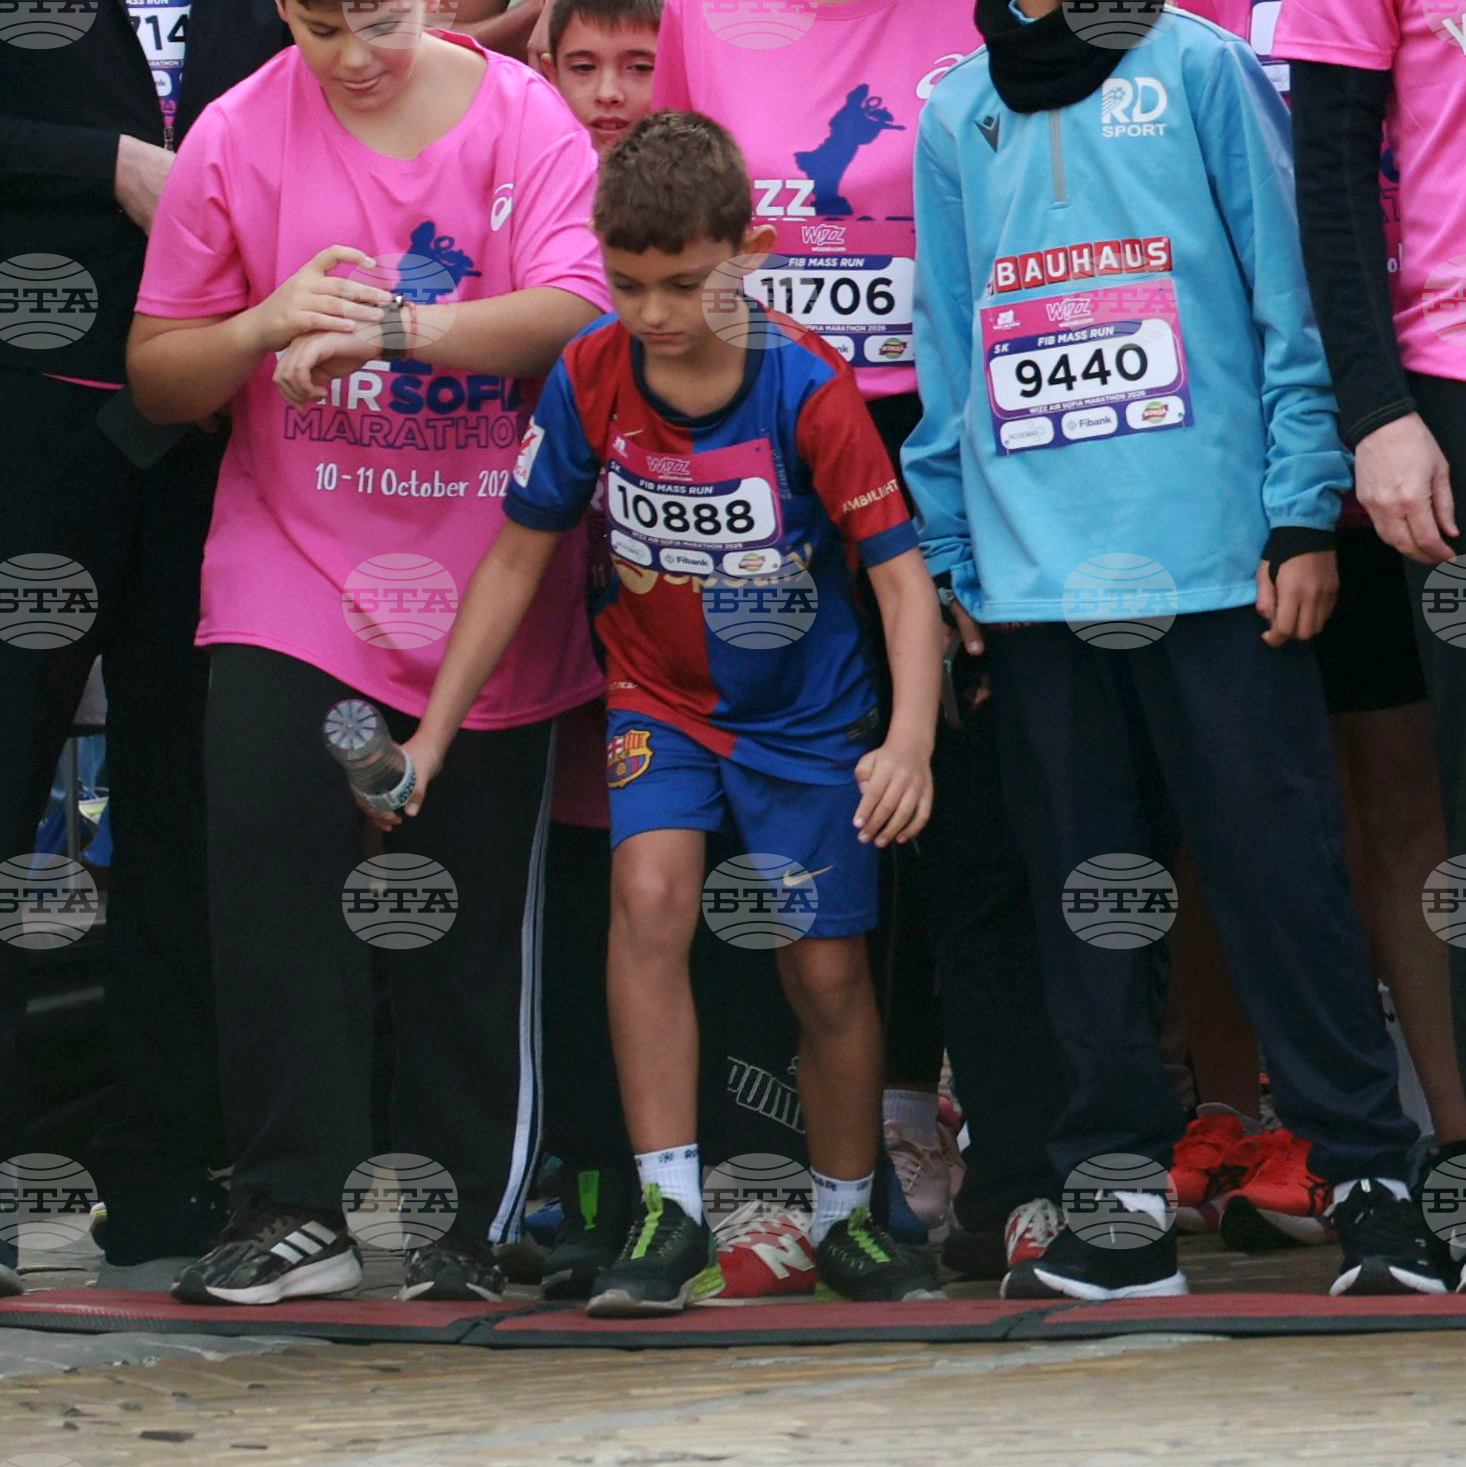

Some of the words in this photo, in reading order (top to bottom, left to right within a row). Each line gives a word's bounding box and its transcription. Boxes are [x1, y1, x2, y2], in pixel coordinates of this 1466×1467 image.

[1102, 123, 1168, 138] SPORT
[808, 257, 838, 267] MASS
[840, 257, 865, 267] RUN
[996, 238, 1168, 287] BAUHAUS
[760, 276, 896, 316] 11706
[1037, 335, 1056, 347] FIB
[1057, 331, 1088, 345] MASS
[1090, 326, 1115, 338] RUN
[1015, 343, 1149, 398] 9440
[388, 374, 522, 415] SOFI
[1063, 401, 1083, 411] SOFIA
[1084, 394, 1127, 406] MARATHON
[284, 406, 516, 451] MARATHO
[1079, 415, 1112, 429] Fibank
[381, 468, 469, 497] October
[477, 470, 508, 497] 202
[656, 483, 684, 494] MASS
[688, 485, 714, 495] RUN
[616, 484, 755, 536] 10888
[675, 555, 710, 568] Fibank
